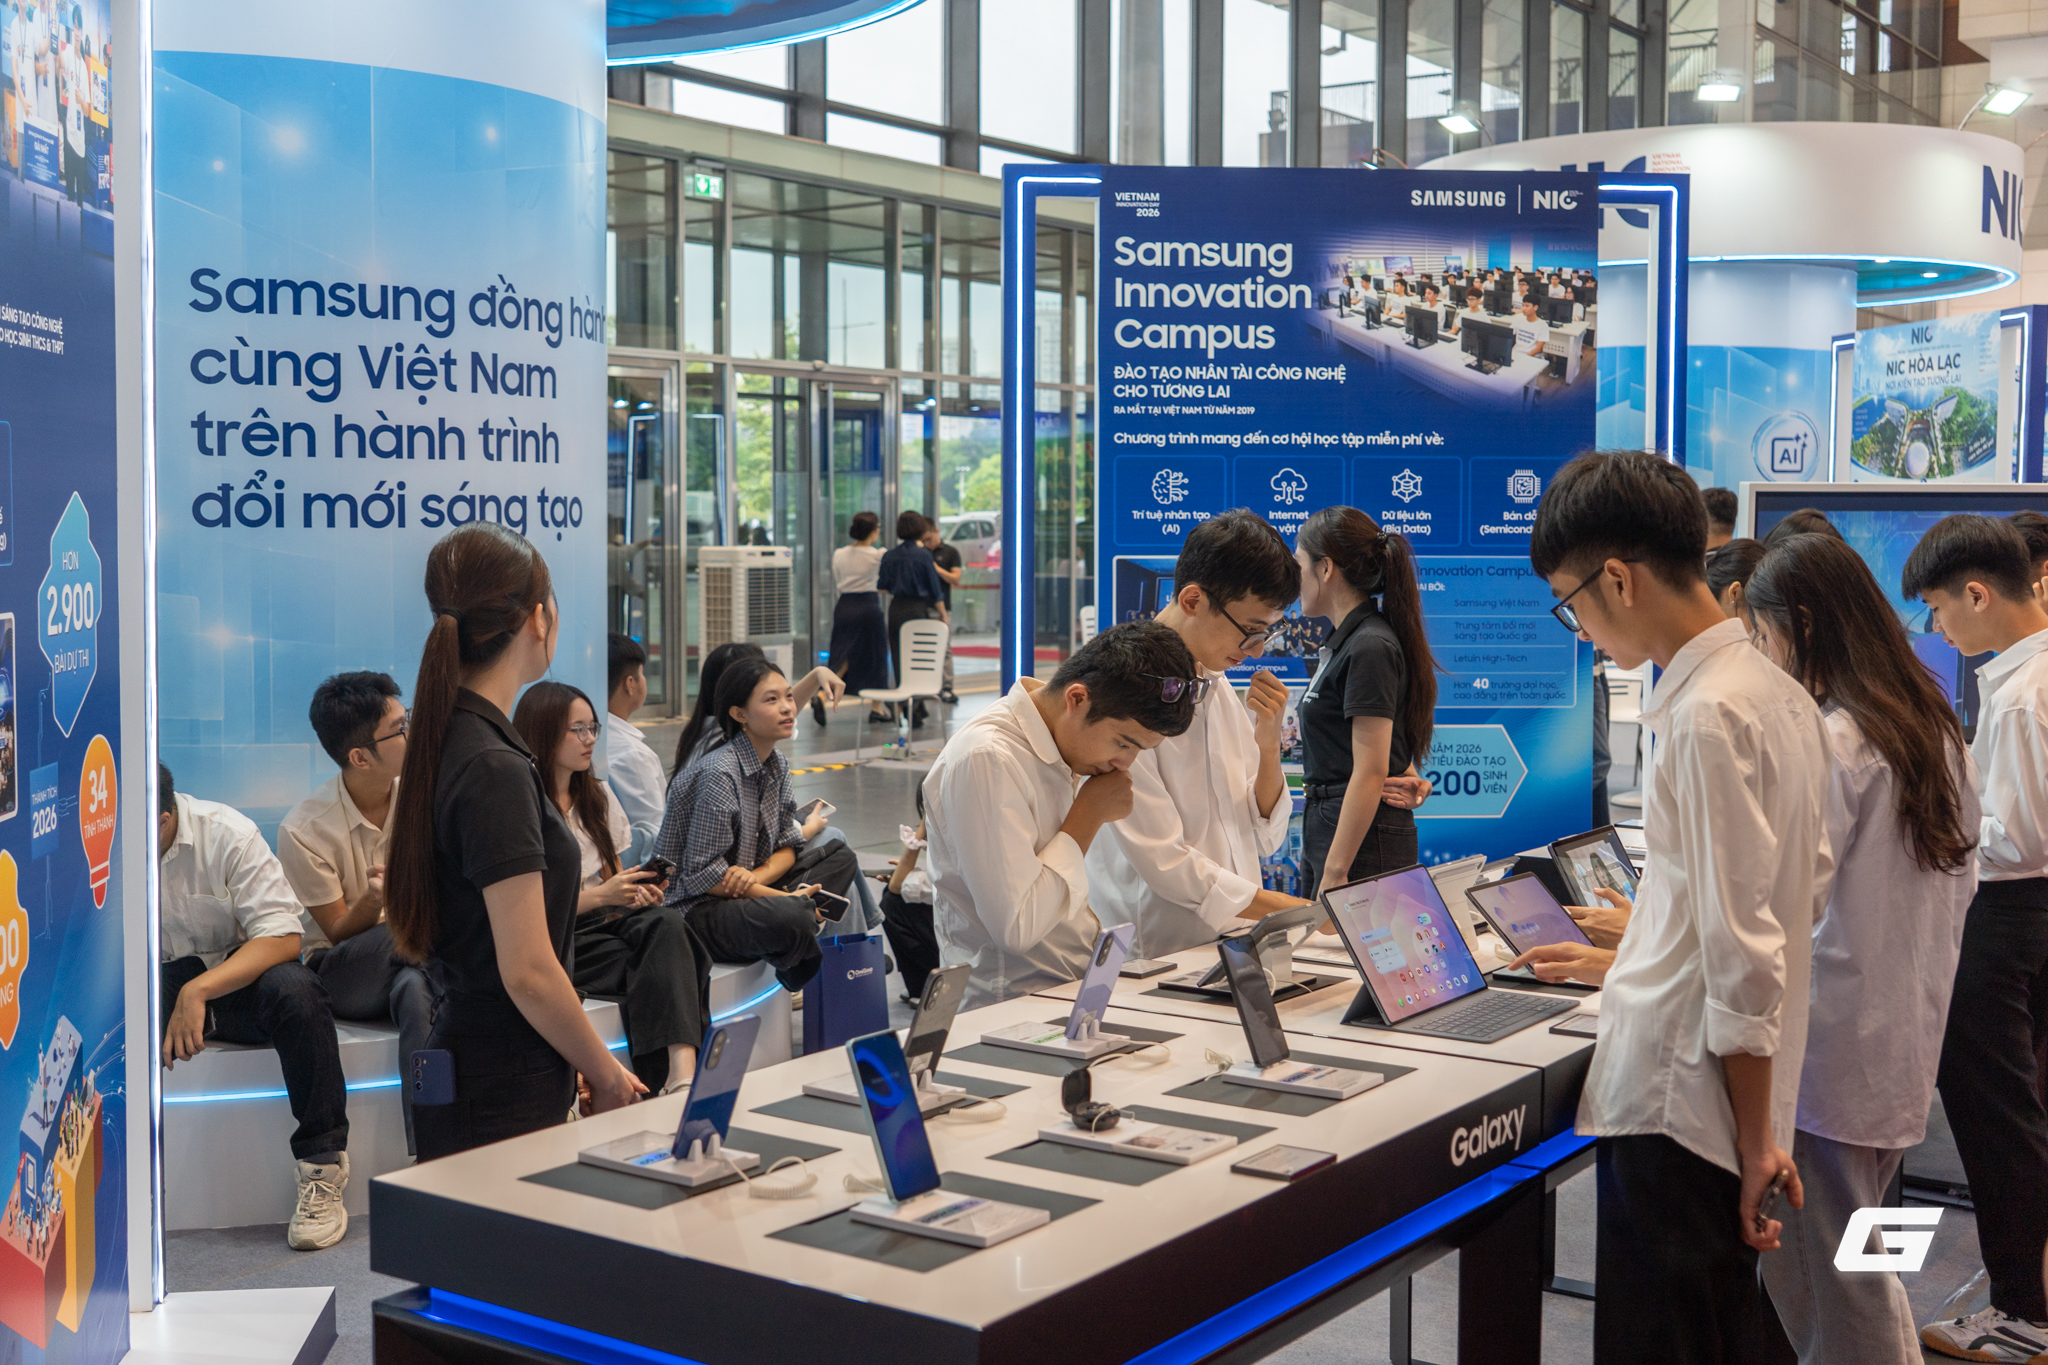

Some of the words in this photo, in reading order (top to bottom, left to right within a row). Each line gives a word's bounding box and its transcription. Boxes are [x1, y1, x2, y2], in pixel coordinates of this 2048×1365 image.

[1115, 192, 1160, 201] VIETNAM
[1411, 190, 1506, 207] SAMSUNG
[1533, 190, 1578, 210] NIC
[1136, 208, 1160, 217] 2026
[1114, 236, 1293, 278] Samsung
[1115, 275, 1312, 308] Innovation
[188, 268, 455, 339] Samsung
[469, 274, 563, 349] đồng
[2, 303, 18, 323] SÁNG
[19, 310, 30, 330] TẠO
[32, 311, 48, 331] CÔNG
[49, 317, 63, 339] NGHỆ
[5, 328, 18, 349] HỌC
[19, 332, 31, 348] SINH
[32, 334, 46, 351] THCS
[47, 338, 51, 352] &
[52, 339, 64, 355] THPT
[1114, 318, 1276, 359] Campus
[190, 336, 342, 403] cùng
[358, 342, 457, 406] Việt
[471, 351, 557, 399] Nam
[1886, 360, 1906, 376] NIC
[1908, 353, 1934, 374] HÒA
[1938, 353, 1961, 377] LẠC
[1114, 363, 1147, 380] ĐÀO
[1150, 366, 1183, 382] TẠO
[1185, 363, 1228, 380] NHÂN
[1231, 364, 1252, 380] TÀI
[1255, 363, 1302, 380] CÔNG
[1305, 364, 1347, 384] NGHỆ
[1113, 384, 1148, 398] CHO
[1151, 384, 1205, 398] TƯƠNG
[1208, 385, 1230, 398] LAI
[1113, 406, 1126, 415] RA
[1127, 402, 1146, 415] MẮT
[1147, 406, 1161, 417] TẠI
[1163, 404, 1180, 416] VIỆT
[1182, 406, 1202, 415] NAM
[1203, 403, 1215, 415] TỪ
[1215, 404, 1236, 415] NĂM
[1236, 406, 1255, 415] 2019
[191, 407, 316, 457] trên
[334, 410, 465, 461] hành
[478, 416, 560, 464] trình
[1113, 432, 1166, 447] Chương
[1168, 431, 1199, 444] trình
[1201, 434, 1241, 447] mang
[1243, 430, 1269, 444] đến
[1272, 433, 1289, 445] cơ
[1291, 432, 1311, 448] hội
[1314, 433, 1339, 448] học
[1341, 432, 1365, 448] tập
[1367, 431, 1400, 445] miễn
[1402, 432, 1422, 448] phí
[1425, 431, 1444, 445] về:
[1779, 448, 1797, 464] AI
[192, 469, 285, 528] đổi
[303, 480, 406, 529] mới
[420, 481, 527, 538] sáng
[537, 486, 583, 542] tạo
[1132, 510, 1145, 520] Trí
[1147, 511, 1163, 522] tuệ
[1165, 510, 1191, 520] nhân
[1192, 511, 1211, 522] tạo
[1269, 510, 1309, 520] Internet
[1382, 511, 1395, 520] Dữ
[1397, 510, 1414, 522] liệu
[1416, 510, 1431, 520] lớn
[1503, 510, 1522, 520] Bán
[1524, 509, 1537, 520] dẫ
[1162, 524, 1180, 535] (AI)
[1278, 523, 1296, 536] vật
[1382, 525, 1401, 534] (Big
[1403, 525, 1431, 535] Data)
[1480, 525, 1533, 536] (Semicond
[62, 551, 79, 570] HƠN
[1419, 565, 1483, 577] nnovation
[1487, 566, 1537, 580] Campu
[47, 582, 94, 636] 2.900
[1454, 599, 1497, 608] Samsung
[1500, 599, 1515, 608] Việt
[1455, 622, 1480, 632] Trung
[1482, 621, 1500, 630] tâm
[1503, 620, 1517, 630] Đổi
[1519, 621, 1536, 630] mới
[1454, 631, 1477, 642] sáng
[1479, 632, 1494, 641] tạo
[1496, 631, 1520, 641] Quốc
[1523, 632, 1537, 642] gia
[55, 649, 66, 674] BÀI
[67, 650, 77, 675] DỰ
[78, 649, 89, 668] THI
[1483, 654, 1528, 665] High-Tech
[1473, 678, 1489, 689] 40
[1491, 681, 1521, 691] trường
[1454, 692, 1471, 700] cao
[1499, 691, 1518, 700] trên
[1520, 691, 1541, 700] toàn
[1543, 690, 1566, 701] quốc
[1456, 744, 1482, 754] 2026
[1432, 755, 1453, 766] TIÊU
[1456, 754, 1480, 766] ĐÀO
[1483, 757, 1506, 768] TẠO
[1483, 771, 1507, 780] SINH
[32, 790, 47, 806] THÀNH
[47, 785, 58, 800] TÍCH
[89, 765, 107, 814] 34
[1483, 783, 1507, 793] VIÊN
[33, 804, 57, 839] 2026
[97, 813, 114, 834] THÀNH
[1450, 1104, 1526, 1167] Galaxy
